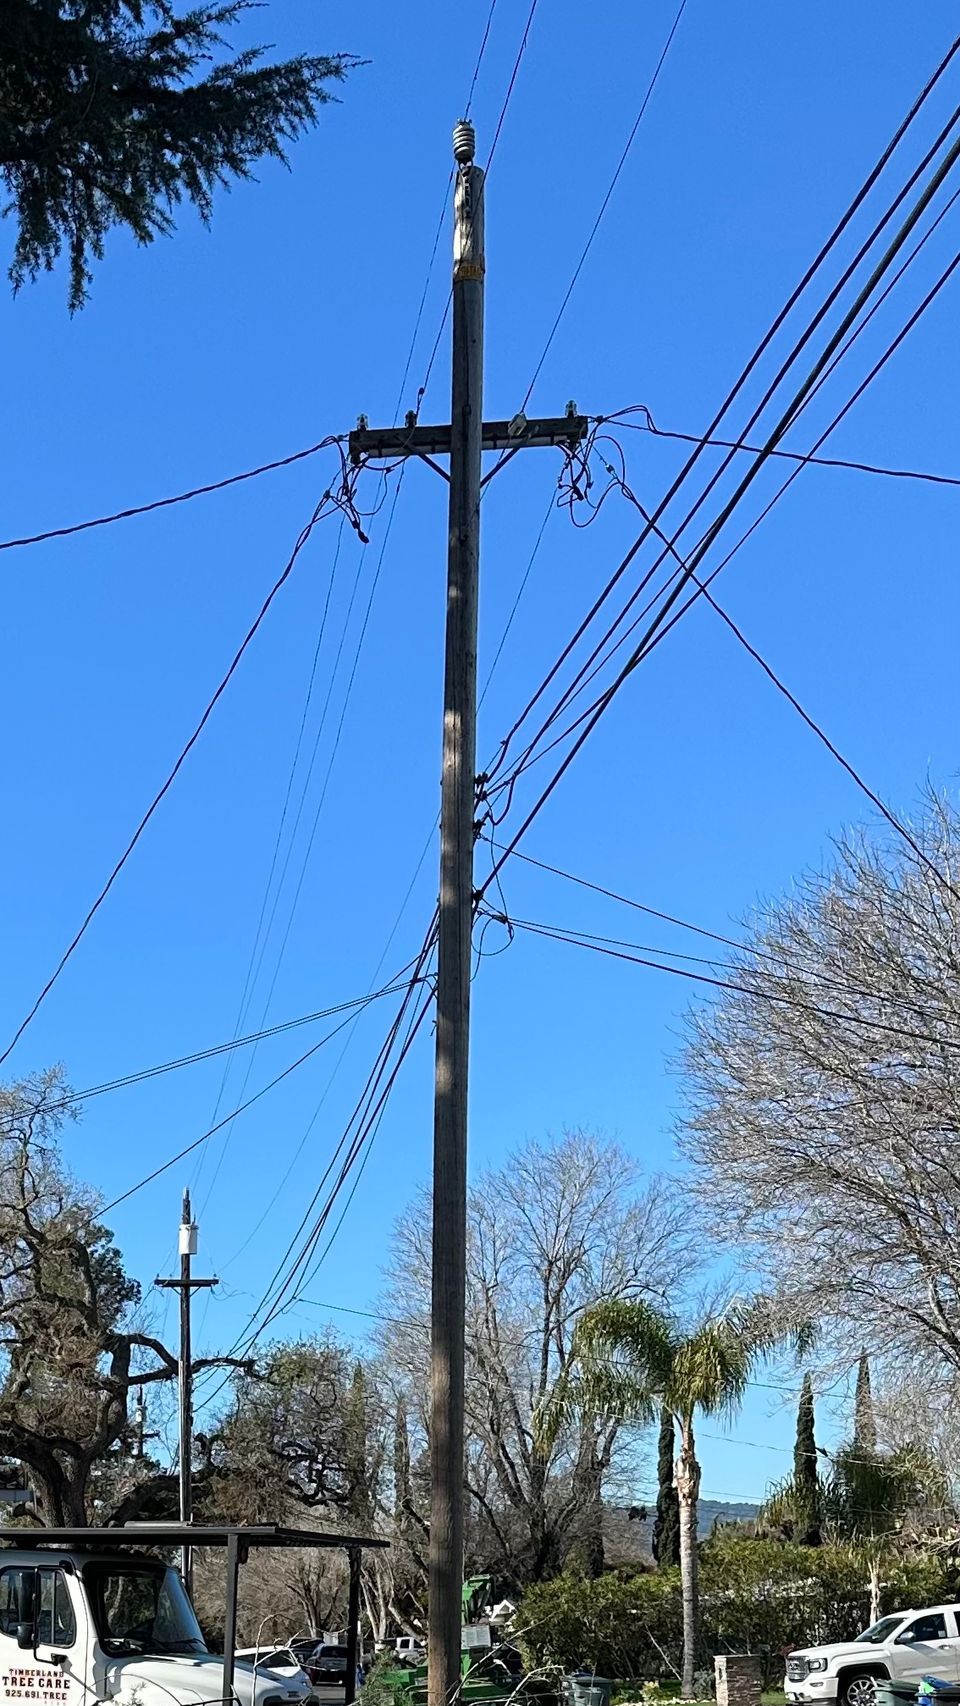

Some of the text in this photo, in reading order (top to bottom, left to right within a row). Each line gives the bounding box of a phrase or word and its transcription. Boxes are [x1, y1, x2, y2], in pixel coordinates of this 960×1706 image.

[9, 1668, 64, 1678] TIMBERLAND
[2, 1676, 70, 1689] TREE CARE
